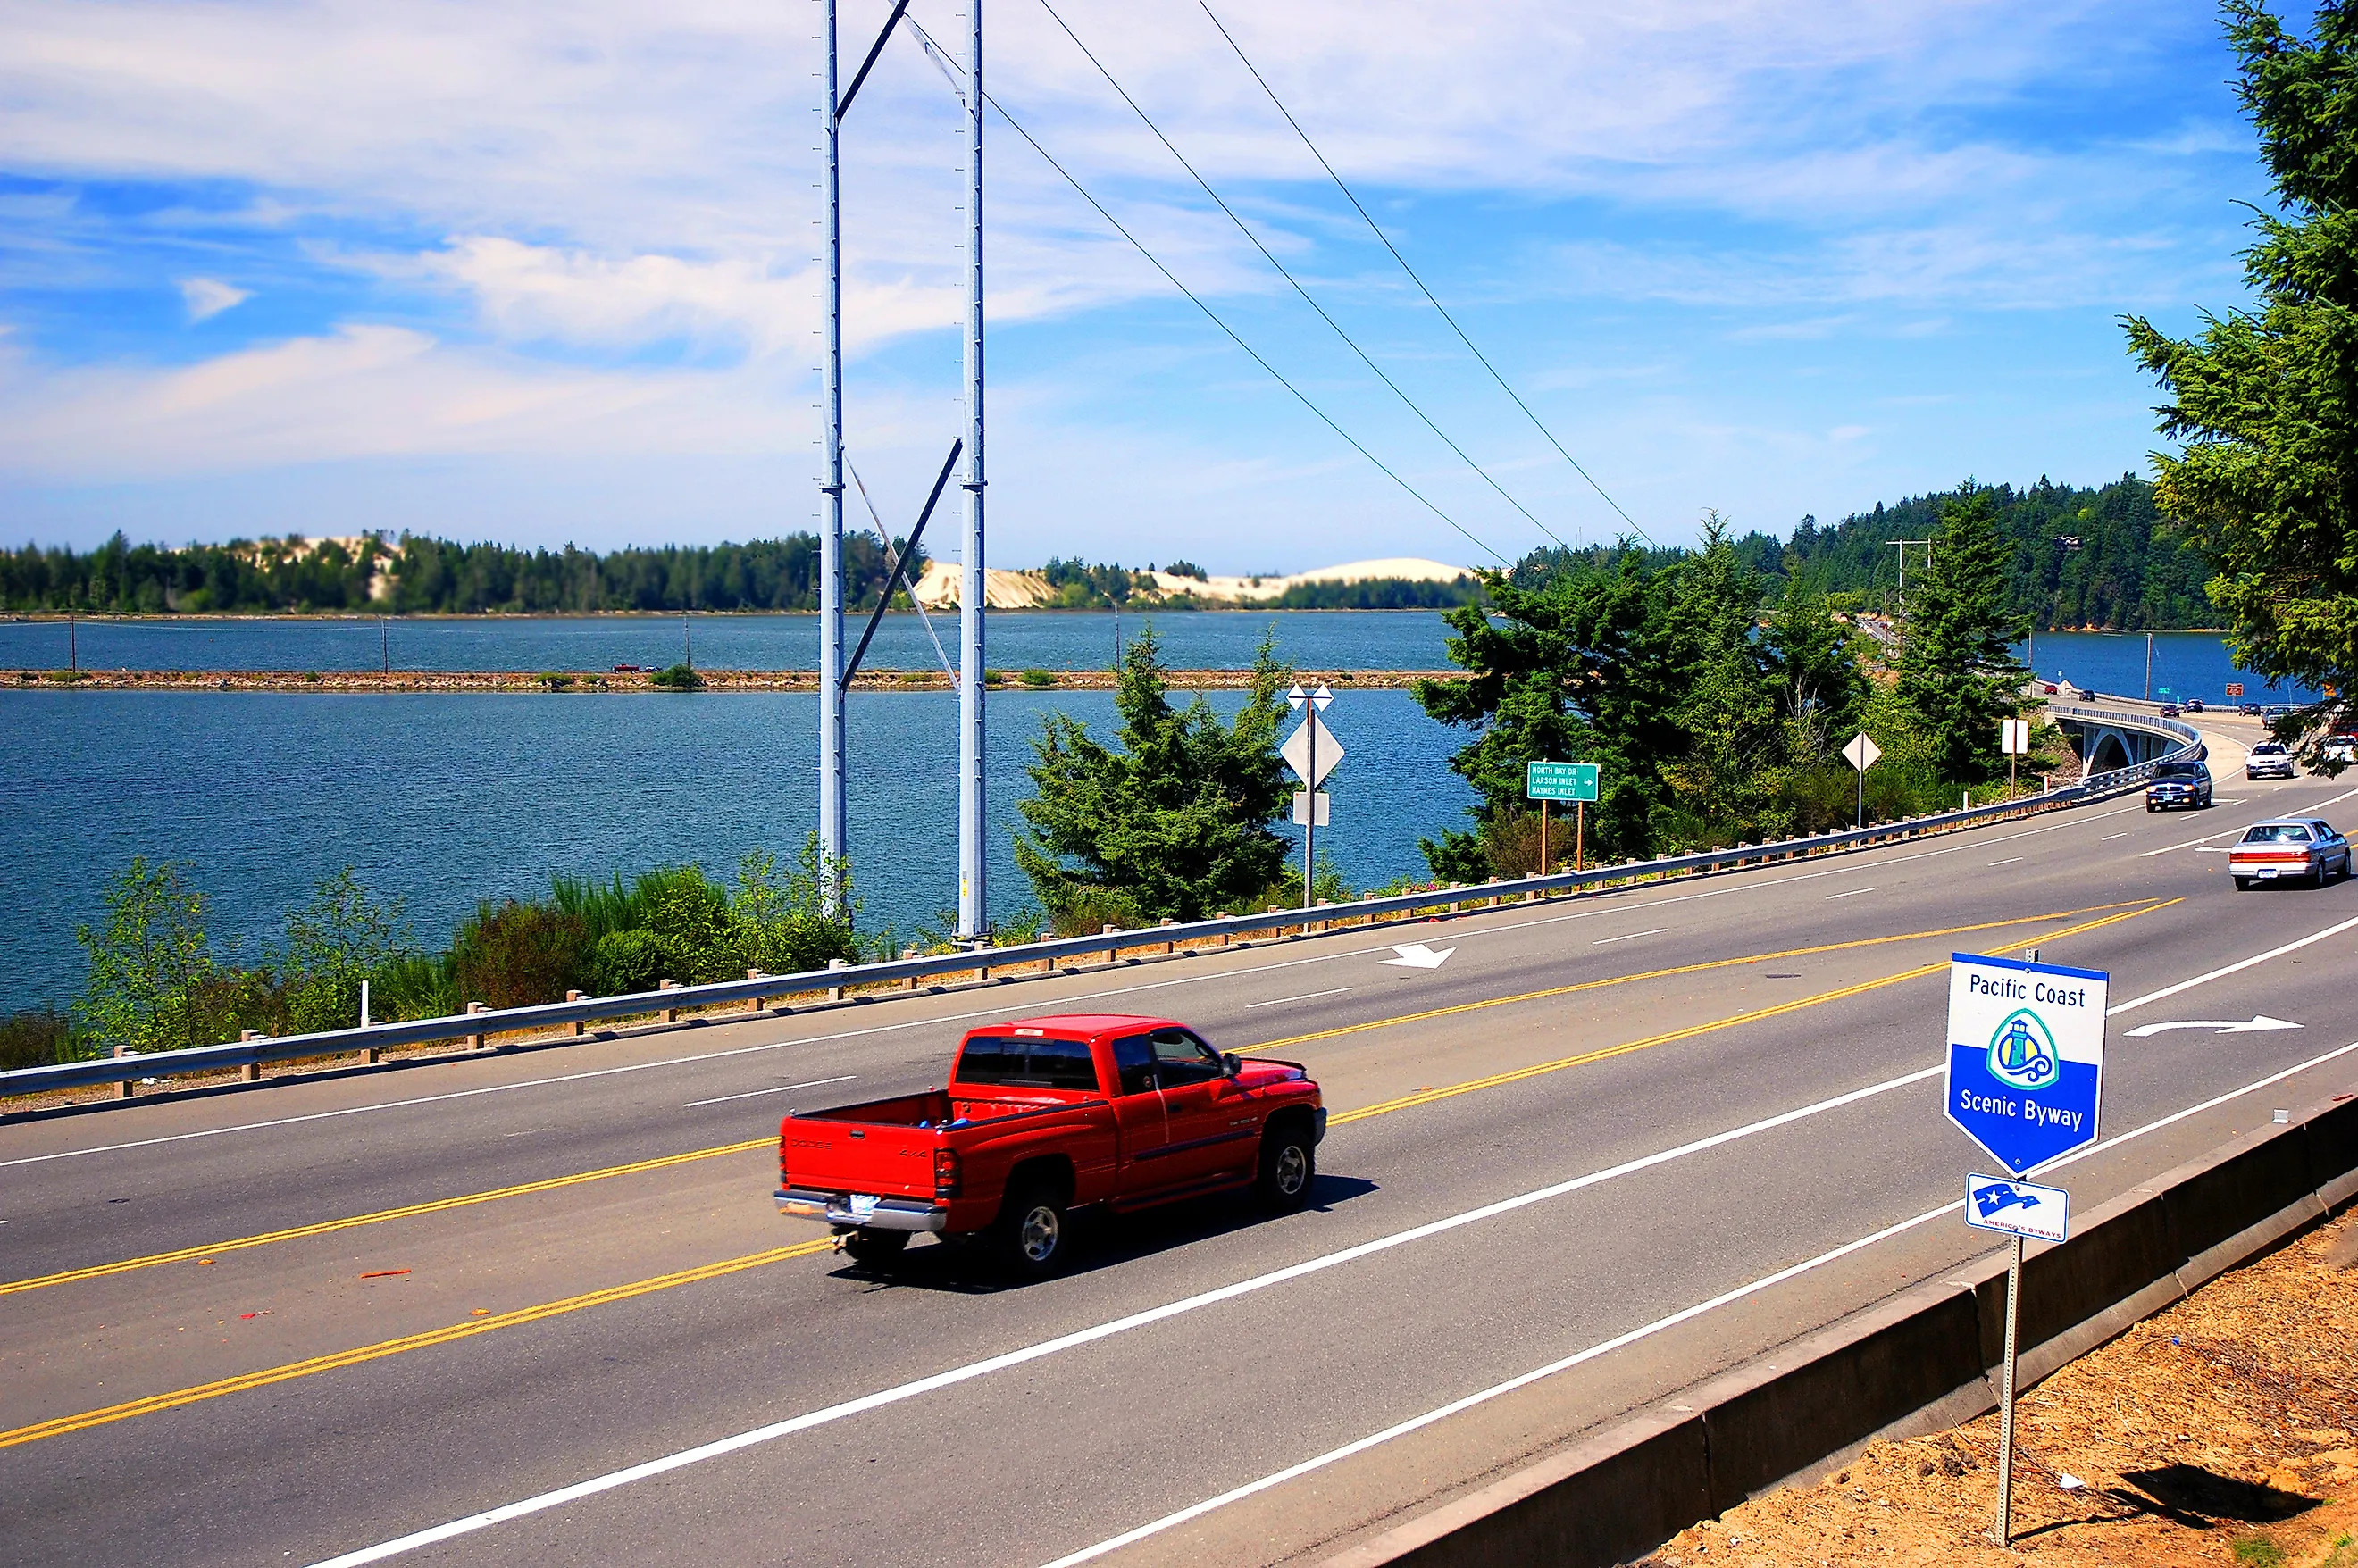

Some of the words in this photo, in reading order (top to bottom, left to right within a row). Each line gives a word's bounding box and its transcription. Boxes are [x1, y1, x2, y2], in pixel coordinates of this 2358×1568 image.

[1532, 766, 1553, 774] NORTH
[1555, 767, 1567, 775] BAY
[1532, 776, 1557, 785] LARSON
[1559, 777, 1576, 786] INLET
[1532, 787, 1555, 796] HAYNES
[1557, 788, 1575, 797] INLET
[1970, 974, 2027, 999] Pacific
[2036, 982, 2086, 1007] Coast
[1960, 1088, 2017, 1117] Scenic
[2024, 1098, 2083, 1133] Byway
[790, 1138, 832, 1150] DODGE
[2028, 1227, 2061, 1239] BYWAYS
